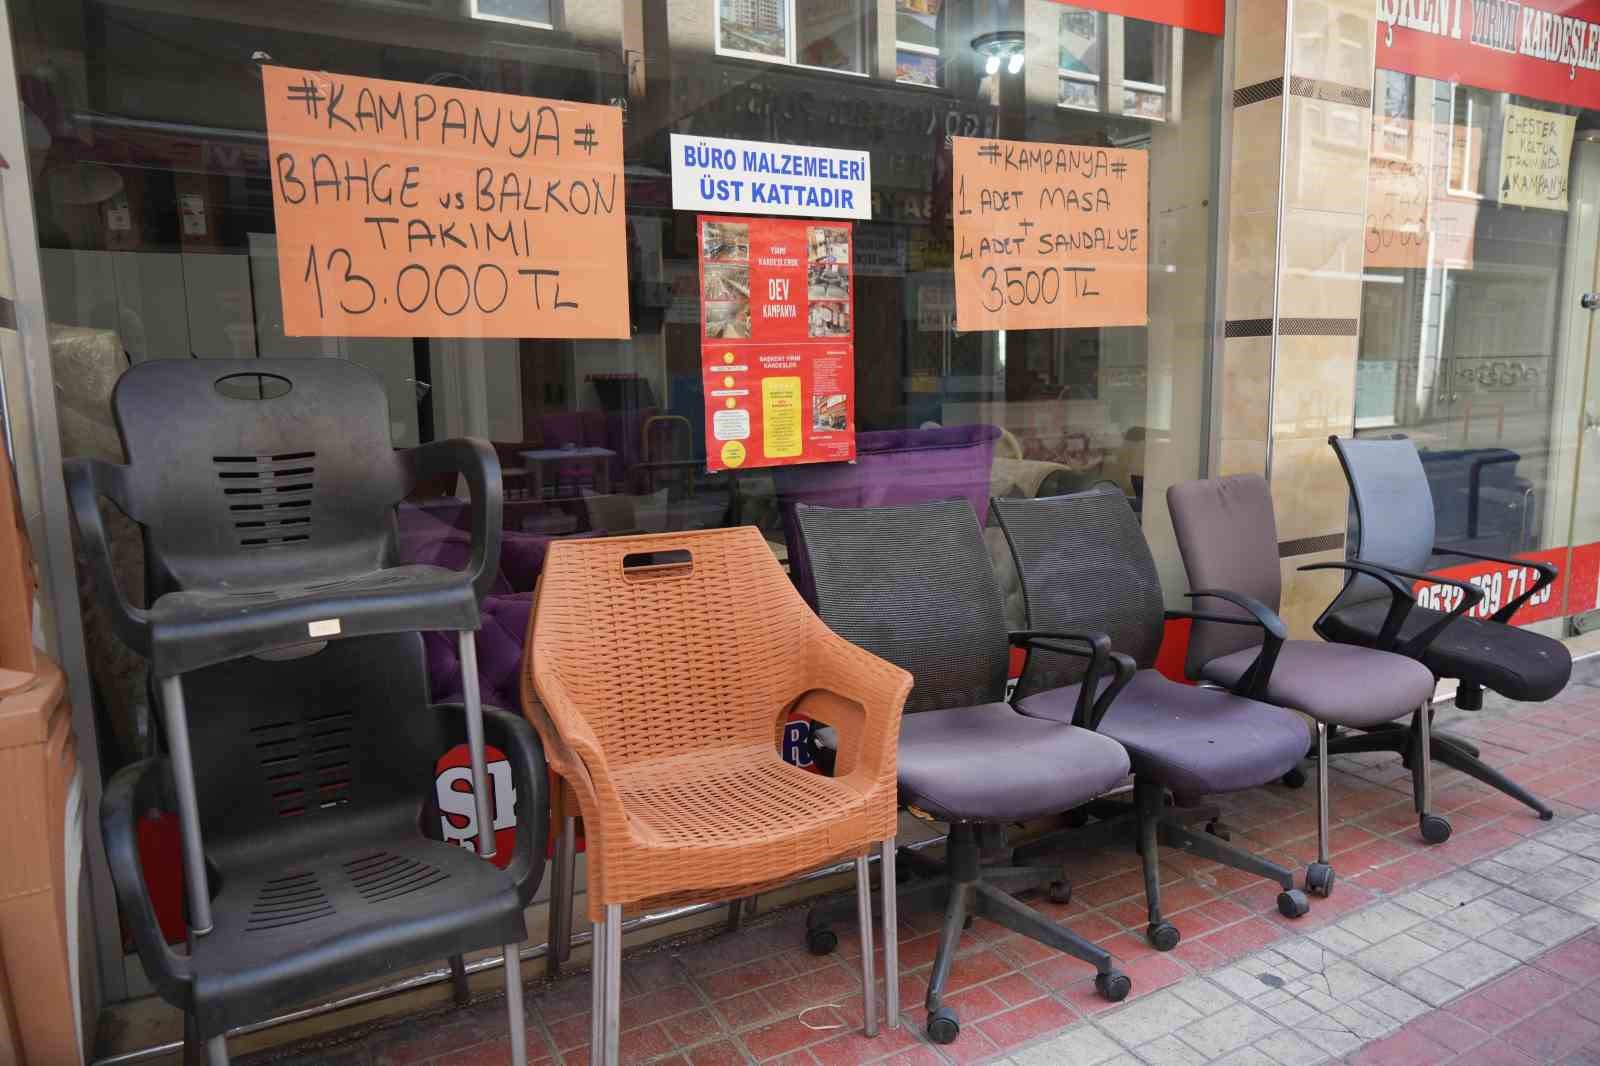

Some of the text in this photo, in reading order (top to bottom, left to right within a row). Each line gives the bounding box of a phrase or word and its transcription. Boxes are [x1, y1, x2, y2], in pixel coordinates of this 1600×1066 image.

[1376, 0, 1462, 48] ŞKENT
[684, 142, 866, 183] BÜRO MALZEMELERİ
[476, 166, 616, 215] BALKON
[700, 174, 743, 201] ÜST
[751, 181, 854, 210] KATTADIR
[959, 175, 973, 214] 1
[981, 189, 1024, 215] ADET
[1039, 187, 1111, 213] MASA
[364, 216, 530, 257] TAKIMI
[979, 237, 1025, 257] ADET
[1038, 227, 1138, 255] SANDALYE
[768, 278, 789, 301] DEV
[762, 304, 797, 318] KAMPANYA
